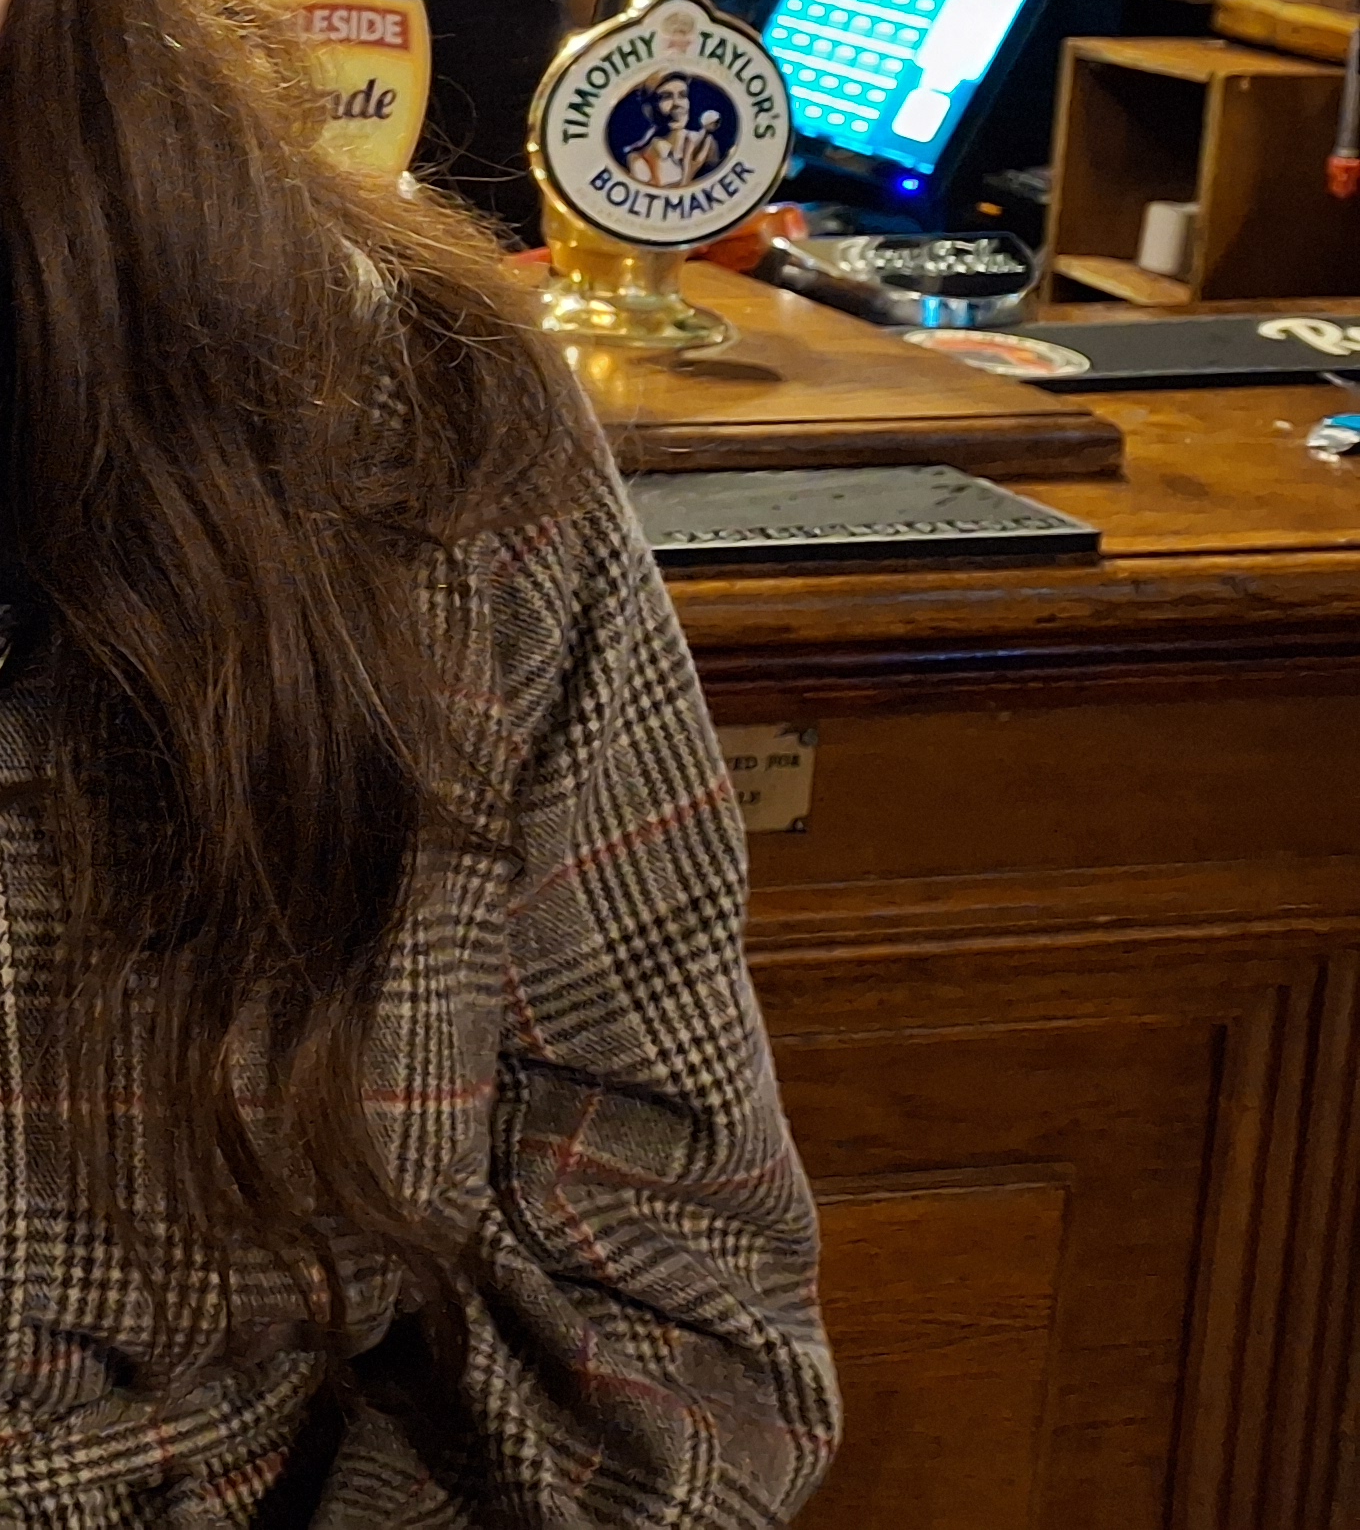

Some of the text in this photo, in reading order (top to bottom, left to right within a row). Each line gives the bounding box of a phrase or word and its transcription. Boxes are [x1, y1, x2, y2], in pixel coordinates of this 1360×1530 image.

[562, 30, 781, 146] TIMOTHY TAYLOR'S
[589, 160, 756, 222] BOLTMAKER
